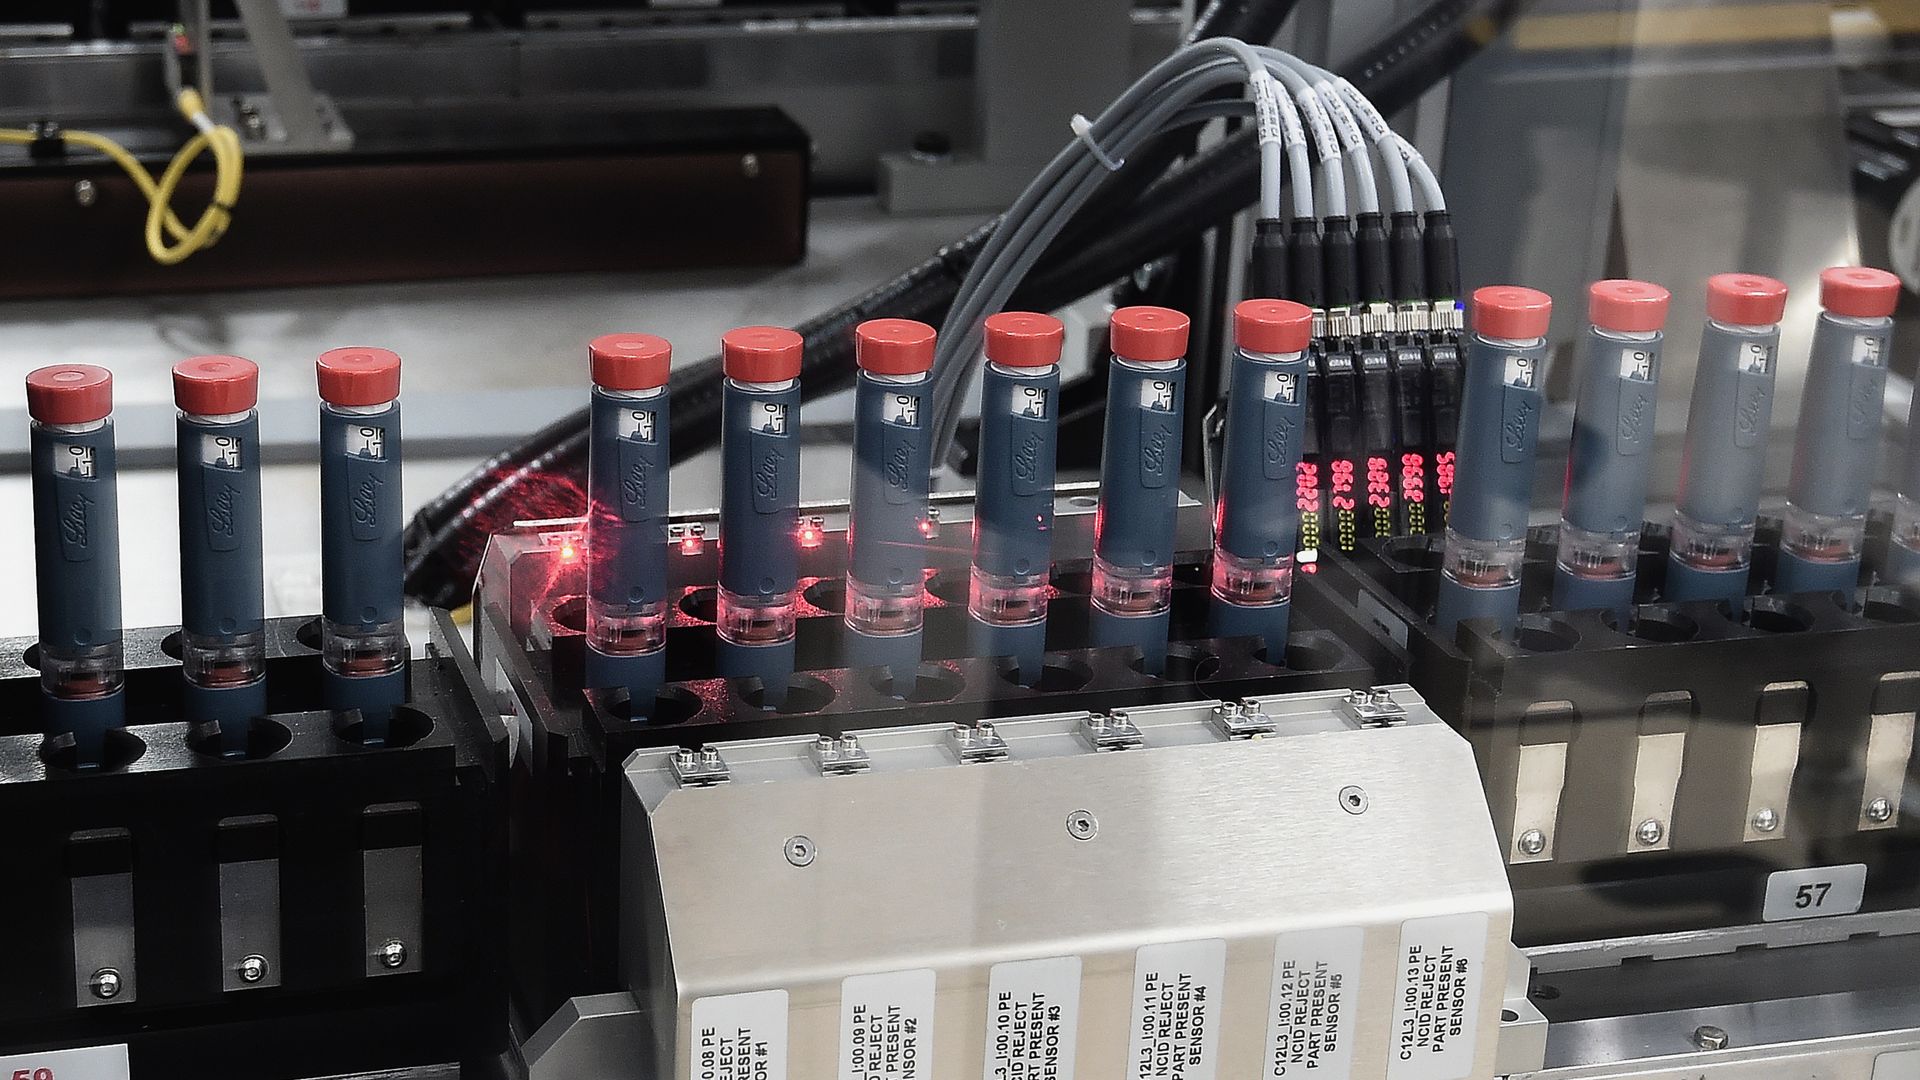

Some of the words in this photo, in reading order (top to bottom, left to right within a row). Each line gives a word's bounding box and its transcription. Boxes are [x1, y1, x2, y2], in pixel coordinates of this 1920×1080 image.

[1795, 882, 1832, 909] 57
[1283, 960, 1296, 979] PE
[1409, 944, 1422, 964] PE
[1145, 972, 1159, 992] PE
[1193, 986, 1207, 1003] #4
[1311, 961, 1329, 1027] PRESENT
[1330, 973, 1343, 989] #5
[1420, 955, 1437, 1010] REJECT
[1436, 945, 1454, 1011] PRESENT
[853, 1004, 867, 1025] PE
[999, 991, 1012, 1011] PE
[1047, 1005, 1061, 1021] #3
[1158, 982, 1174, 1038] REJECT
[1175, 973, 1192, 1040] PRESENT
[1293, 970, 1311, 1026] REJECT
[1450, 977, 1466, 1036] SENSOR
[702, 1026, 716, 1048] PE
[886, 1005, 901, 1073] PRESENT
[903, 1017, 918, 1034] #2
[1012, 1001, 1028, 1056] REJECT
[1029, 992, 1045, 1060] PRESENT
[1189, 1005, 1206, 1066] SENSOR
[1324, 993, 1341, 1052] SENSOR
[1417, 1012, 1431, 1047] NCID
[1433, 1015, 1447, 1052] PART
[755, 1040, 768, 1056] #1
[869, 1014, 884, 1071] REJECT
[1156, 1040, 1170, 1077] NCID
[1291, 1028, 1306, 1064] NCID
[1307, 1031, 1322, 1069] PART
[1171, 1045, 1186, 1080] PART
